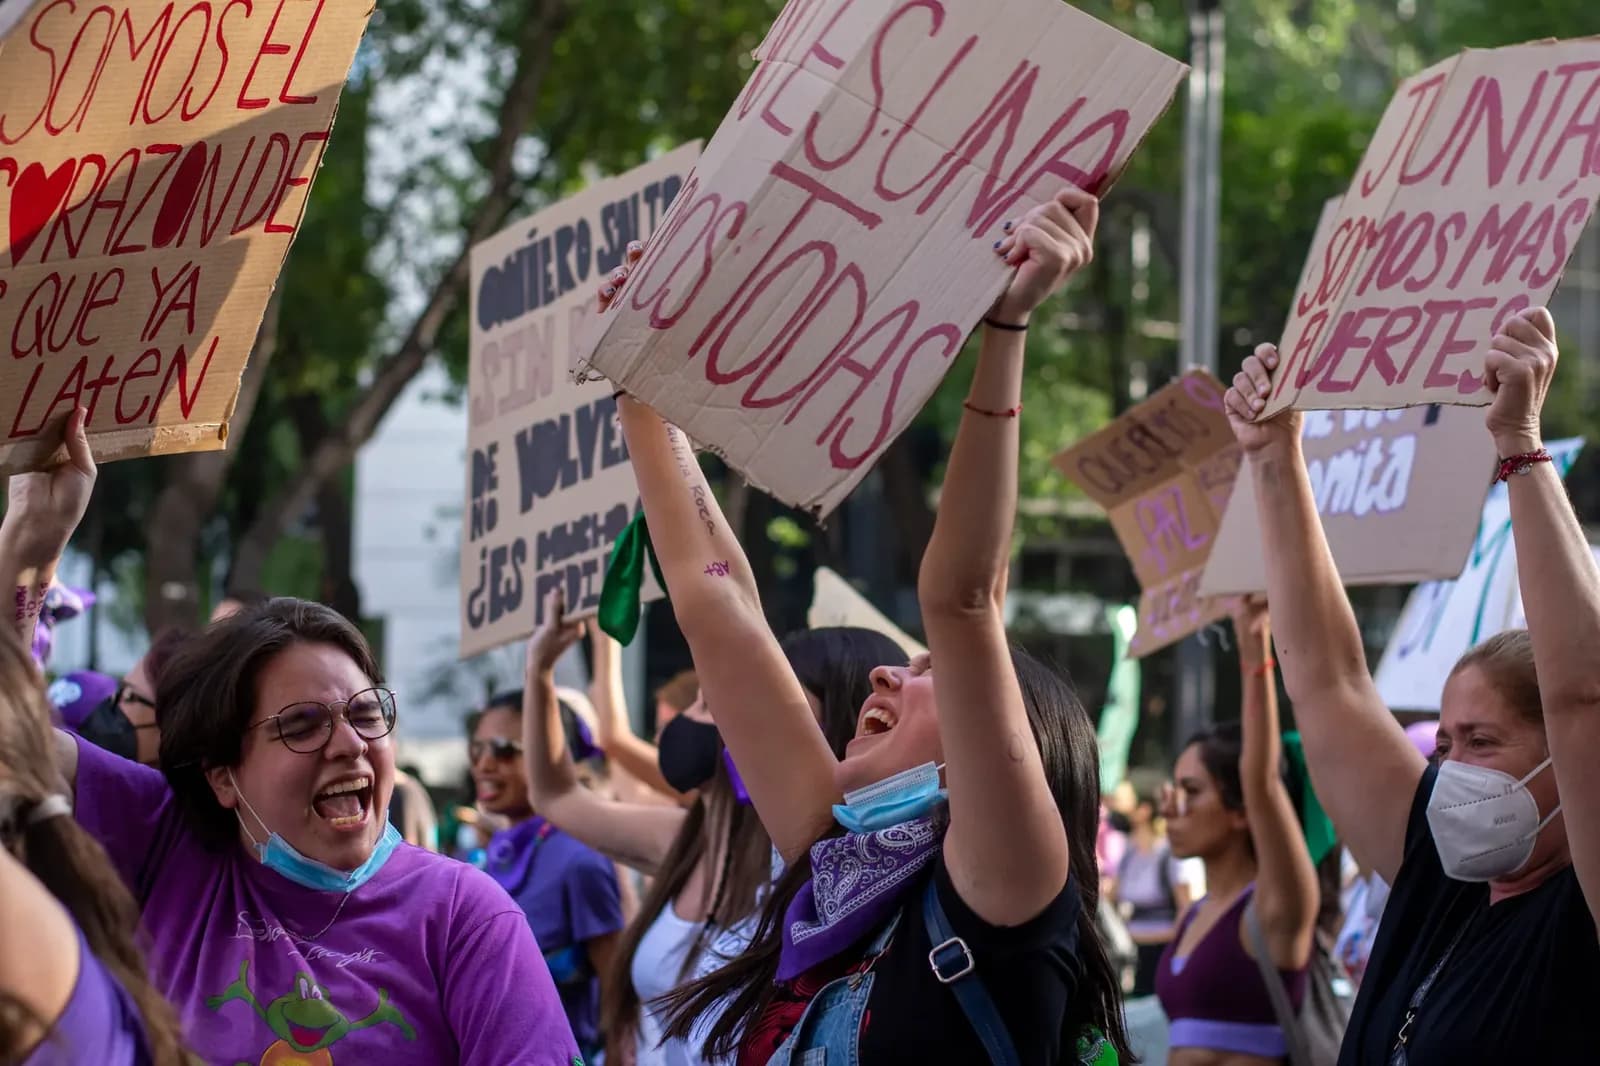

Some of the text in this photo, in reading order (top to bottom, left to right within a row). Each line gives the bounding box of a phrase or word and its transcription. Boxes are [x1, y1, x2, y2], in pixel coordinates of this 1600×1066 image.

[237, 0, 326, 109] EL
[231, 132, 330, 235] DE
[1360, 61, 1600, 198] JUNTA
[140, 260, 201, 343] YA
[688, 160, 962, 471] TODAS
[1297, 210, 1467, 318] SOMOS
[514, 396, 630, 515] VOLVE
